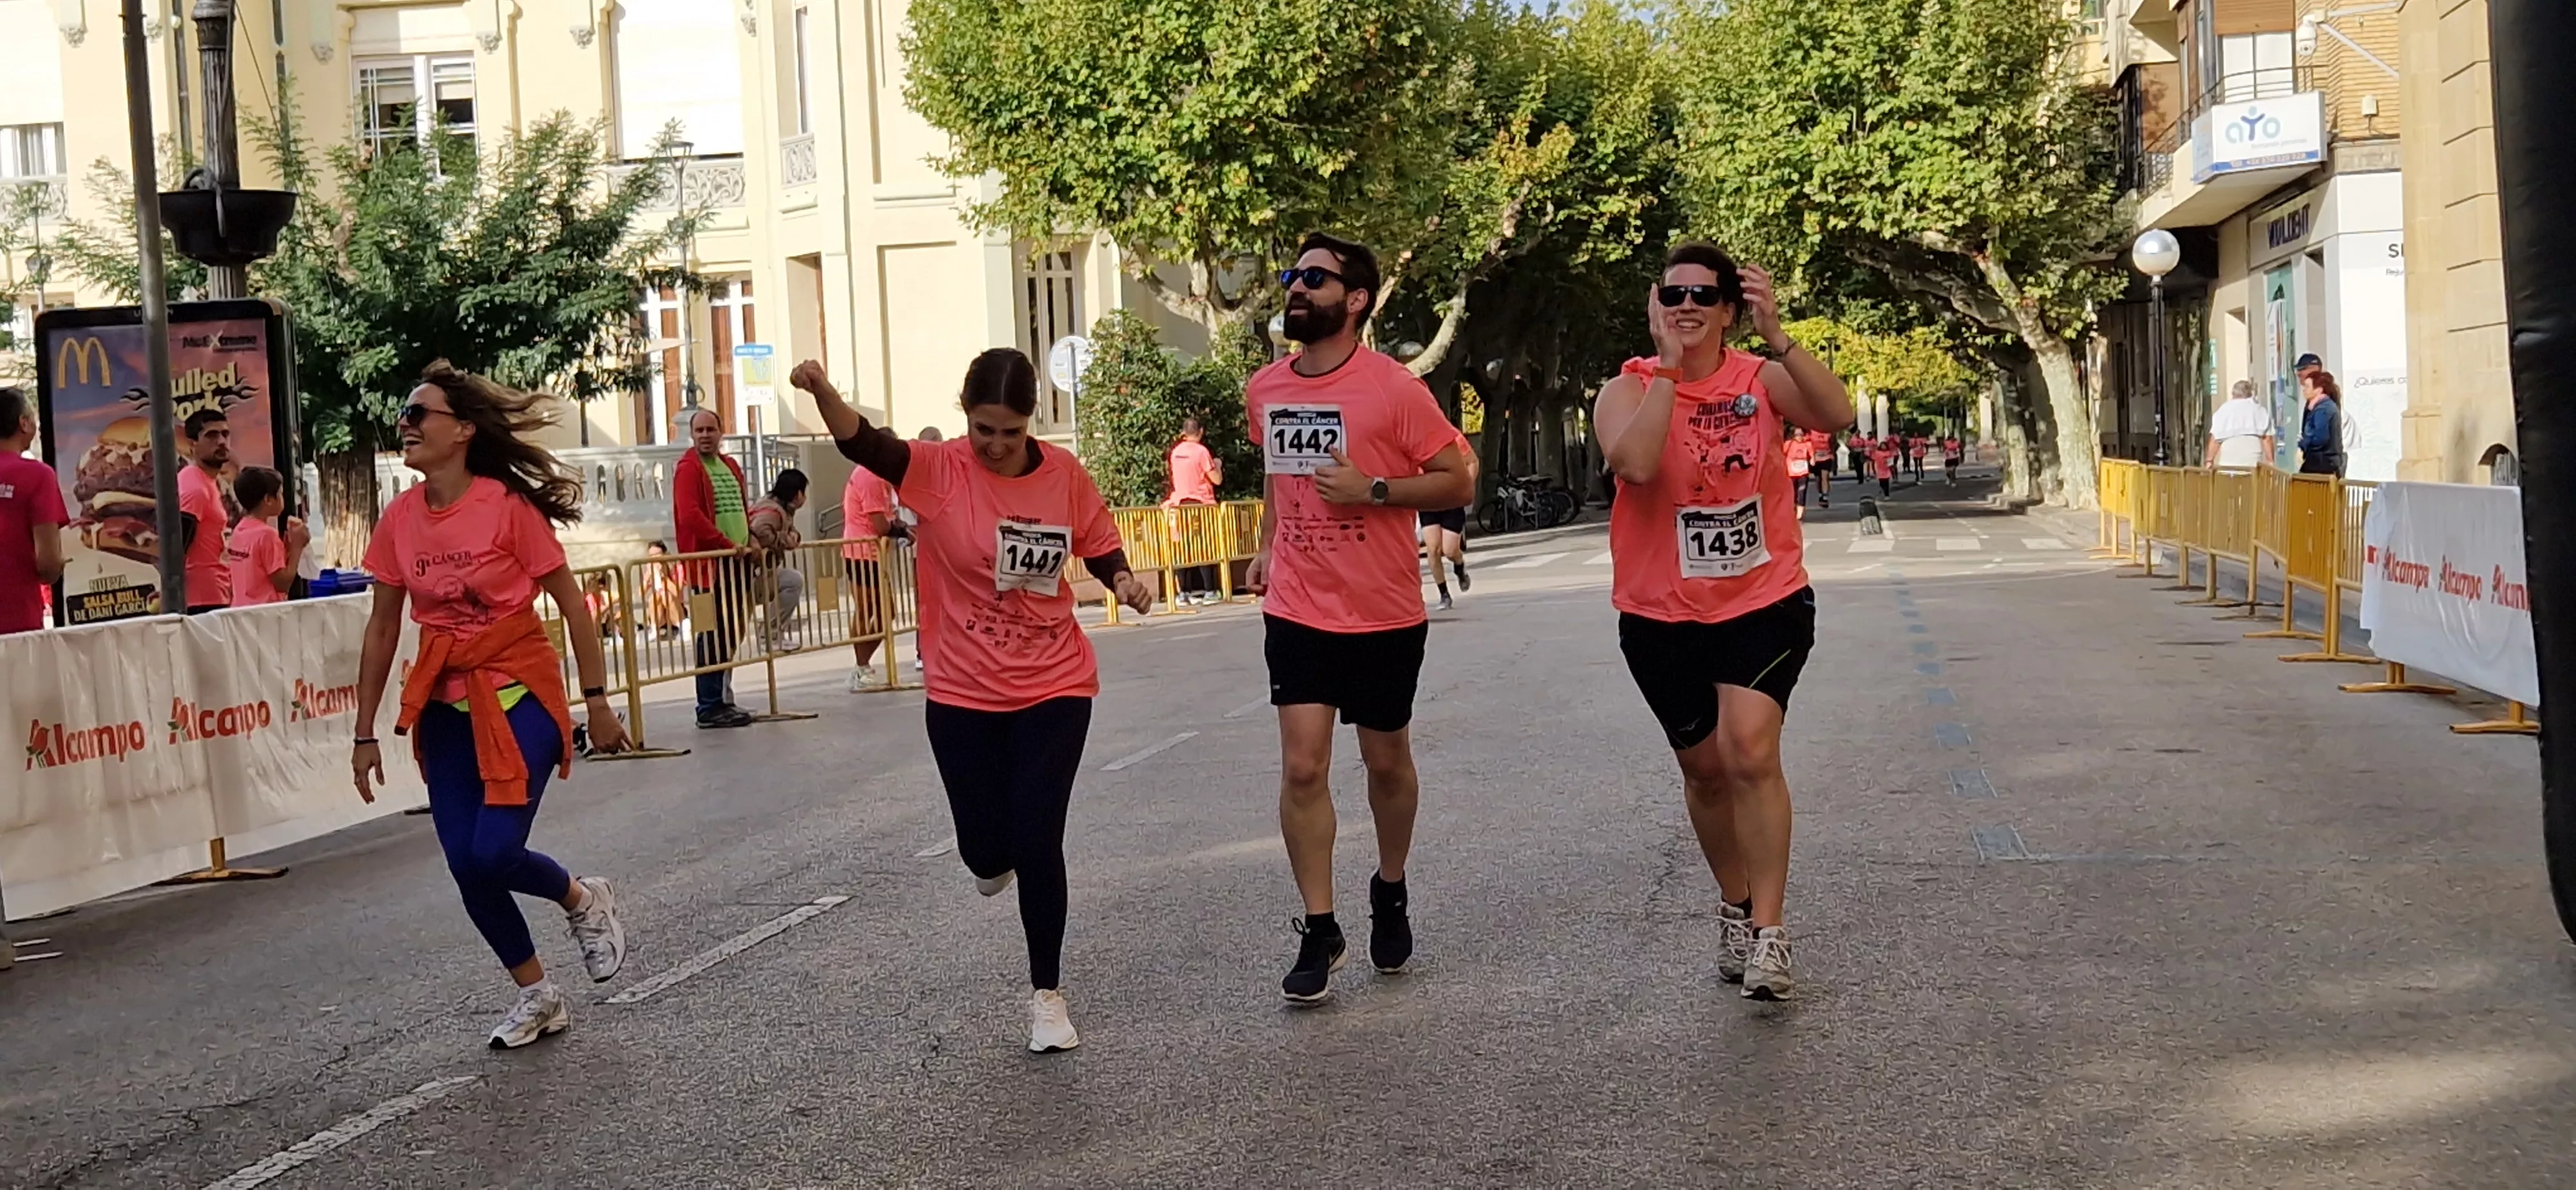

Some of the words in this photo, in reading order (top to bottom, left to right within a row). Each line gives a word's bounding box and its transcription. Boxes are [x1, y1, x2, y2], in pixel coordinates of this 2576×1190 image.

[171, 361, 238, 397] ulled
[1274, 429, 1338, 454] 1442
[1689, 521, 1758, 556] 1438
[1007, 545, 1063, 574] 1441
[88, 574, 129, 592] NUEVA
[2382, 545, 2430, 593] Alcampo
[2438, 554, 2483, 605] Alcampo
[73, 609, 88, 621] DE
[89, 605, 113, 619] DANI
[83, 592, 116, 609] SALSA
[26, 719, 145, 771] Alcampo
